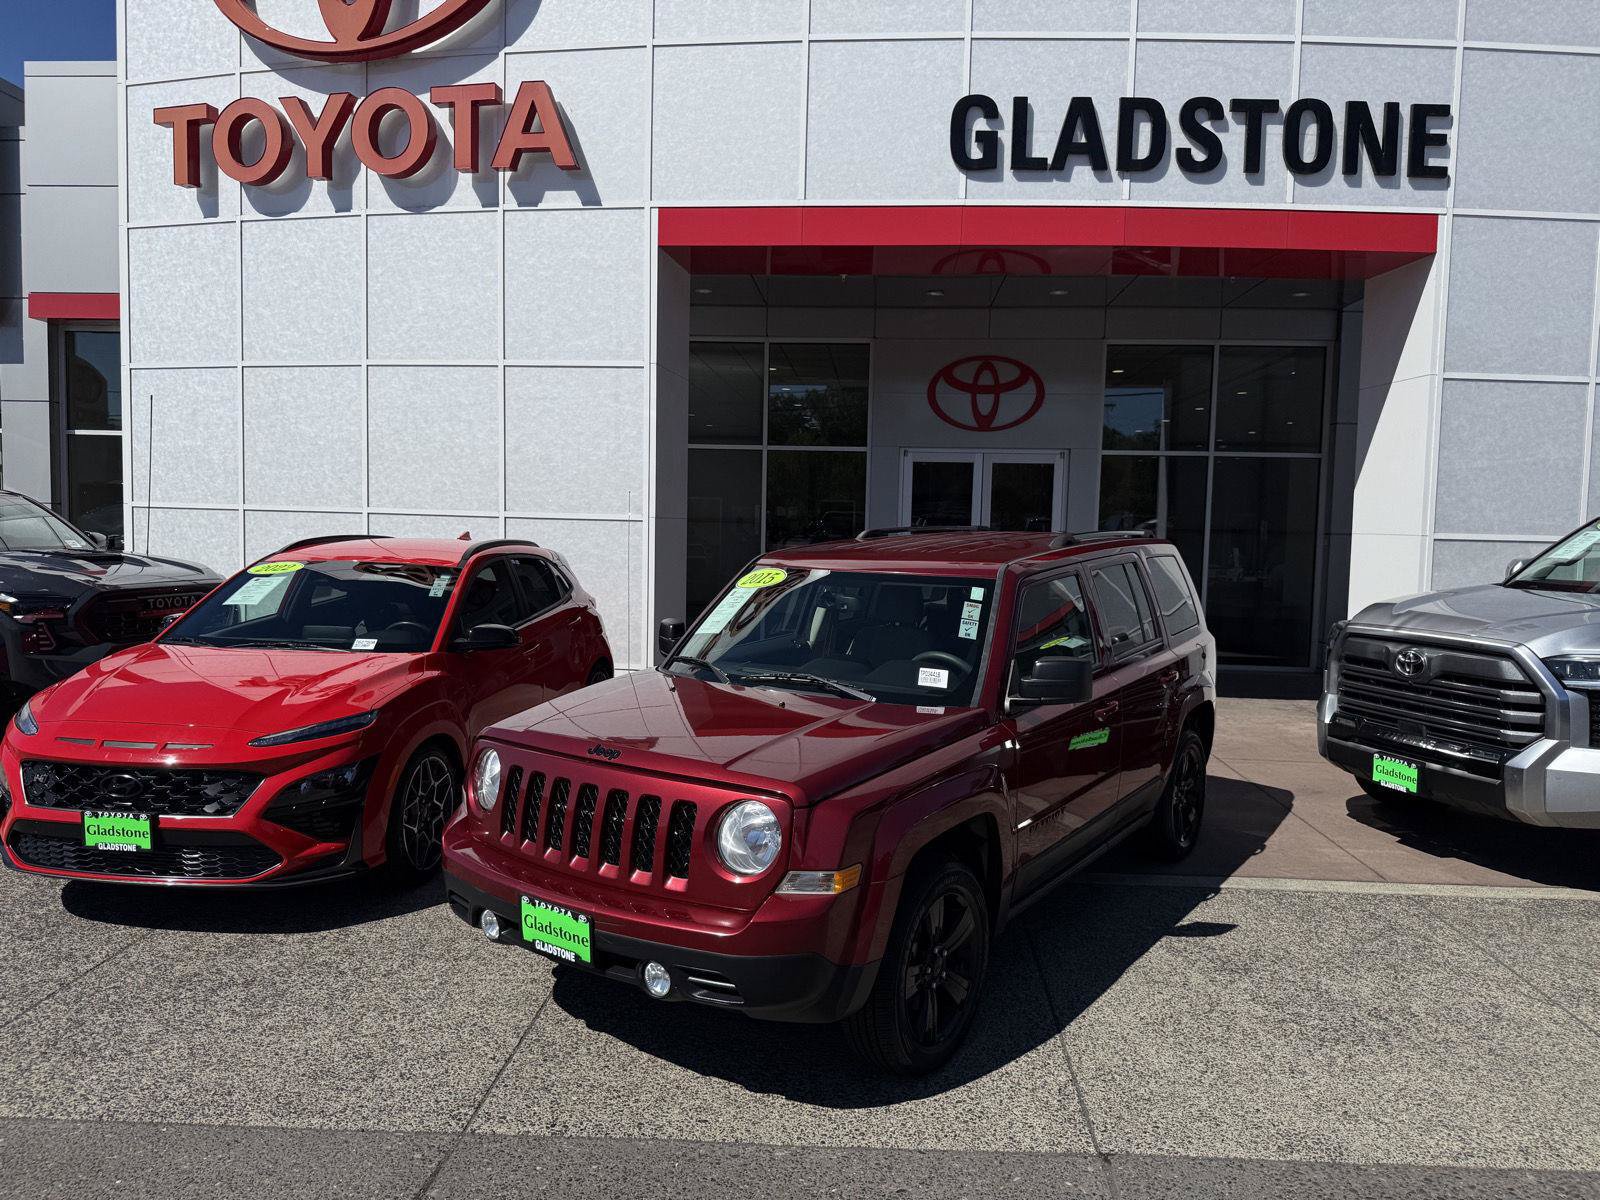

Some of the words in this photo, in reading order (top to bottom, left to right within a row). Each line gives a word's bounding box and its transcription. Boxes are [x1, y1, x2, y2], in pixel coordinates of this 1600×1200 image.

[153, 80, 581, 188] TOYOTA
[950, 94, 1452, 179] GLADSTONE
[740, 572, 781, 586] 2015
[147, 596, 197, 609] TOYOTA
[588, 744, 621, 760] Jeep
[1382, 755, 1408, 766] TOYOTA
[1375, 764, 1417, 785] Gladstone
[1380, 780, 1407, 793] GLADSTONE
[98, 811, 134, 819] TOYOTA
[86, 824, 149, 839] Gladstone
[98, 843, 137, 852] GLADSTONE
[534, 899, 573, 918] TOYOTA
[524, 913, 589, 947] Gladstone
[535, 940, 576, 962] GLADSTONE
